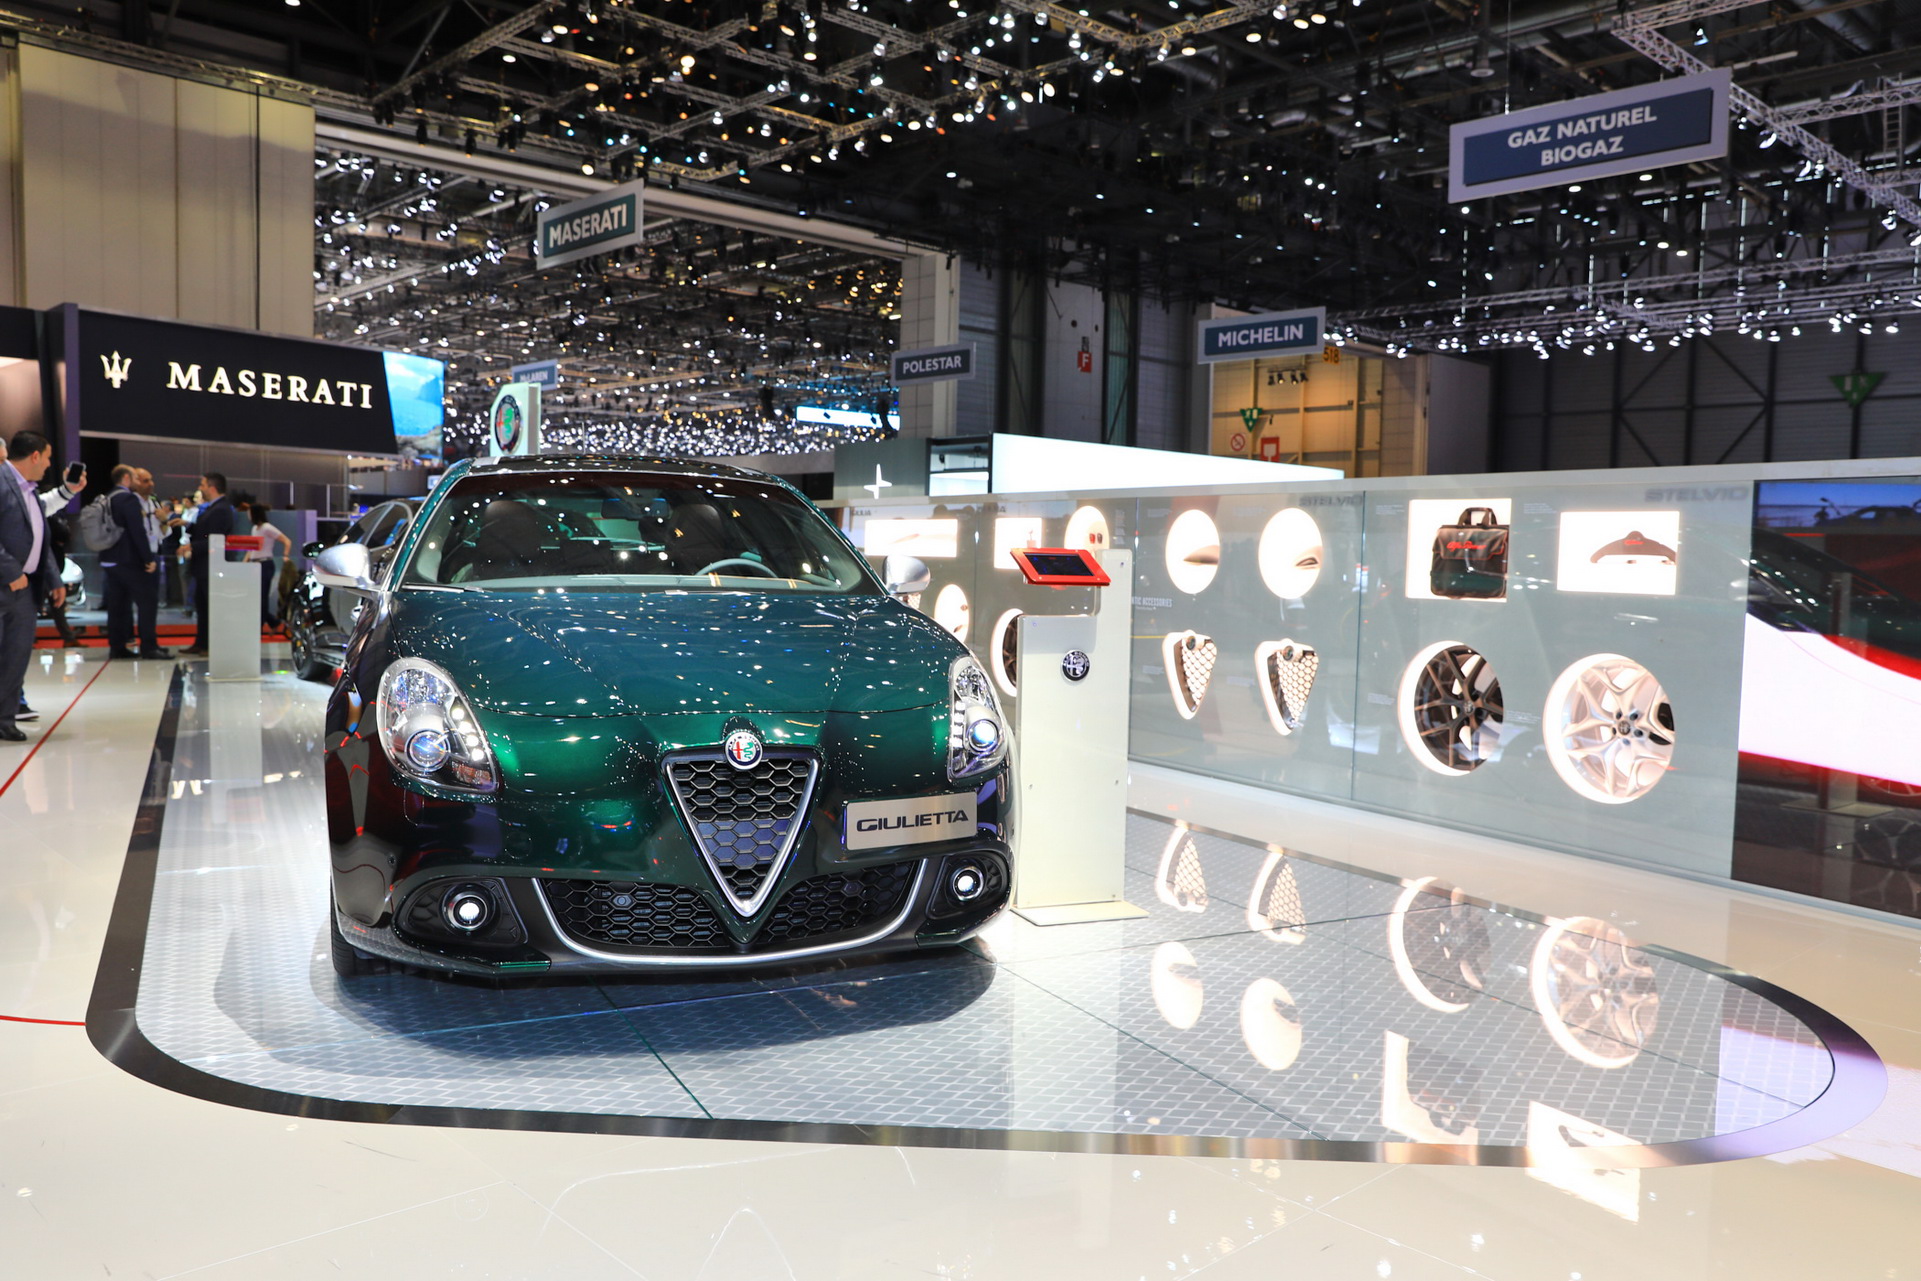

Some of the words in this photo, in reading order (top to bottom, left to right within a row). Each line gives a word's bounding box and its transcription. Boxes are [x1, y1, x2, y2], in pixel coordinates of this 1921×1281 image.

[1507, 125, 1552, 149] GAZ
[1556, 105, 1658, 140] NATUREL
[1541, 135, 1624, 167] BIOGAZ
[549, 203, 627, 249] MASERATI
[1217, 323, 1304, 348] MICHELIN
[902, 355, 962, 375] POLESTAR
[1081, 353, 1090, 368] F
[166, 361, 373, 409] MASERATI
[1644, 486, 1749, 503] STELVIO
[856, 809, 969, 832] GIULIETTA
